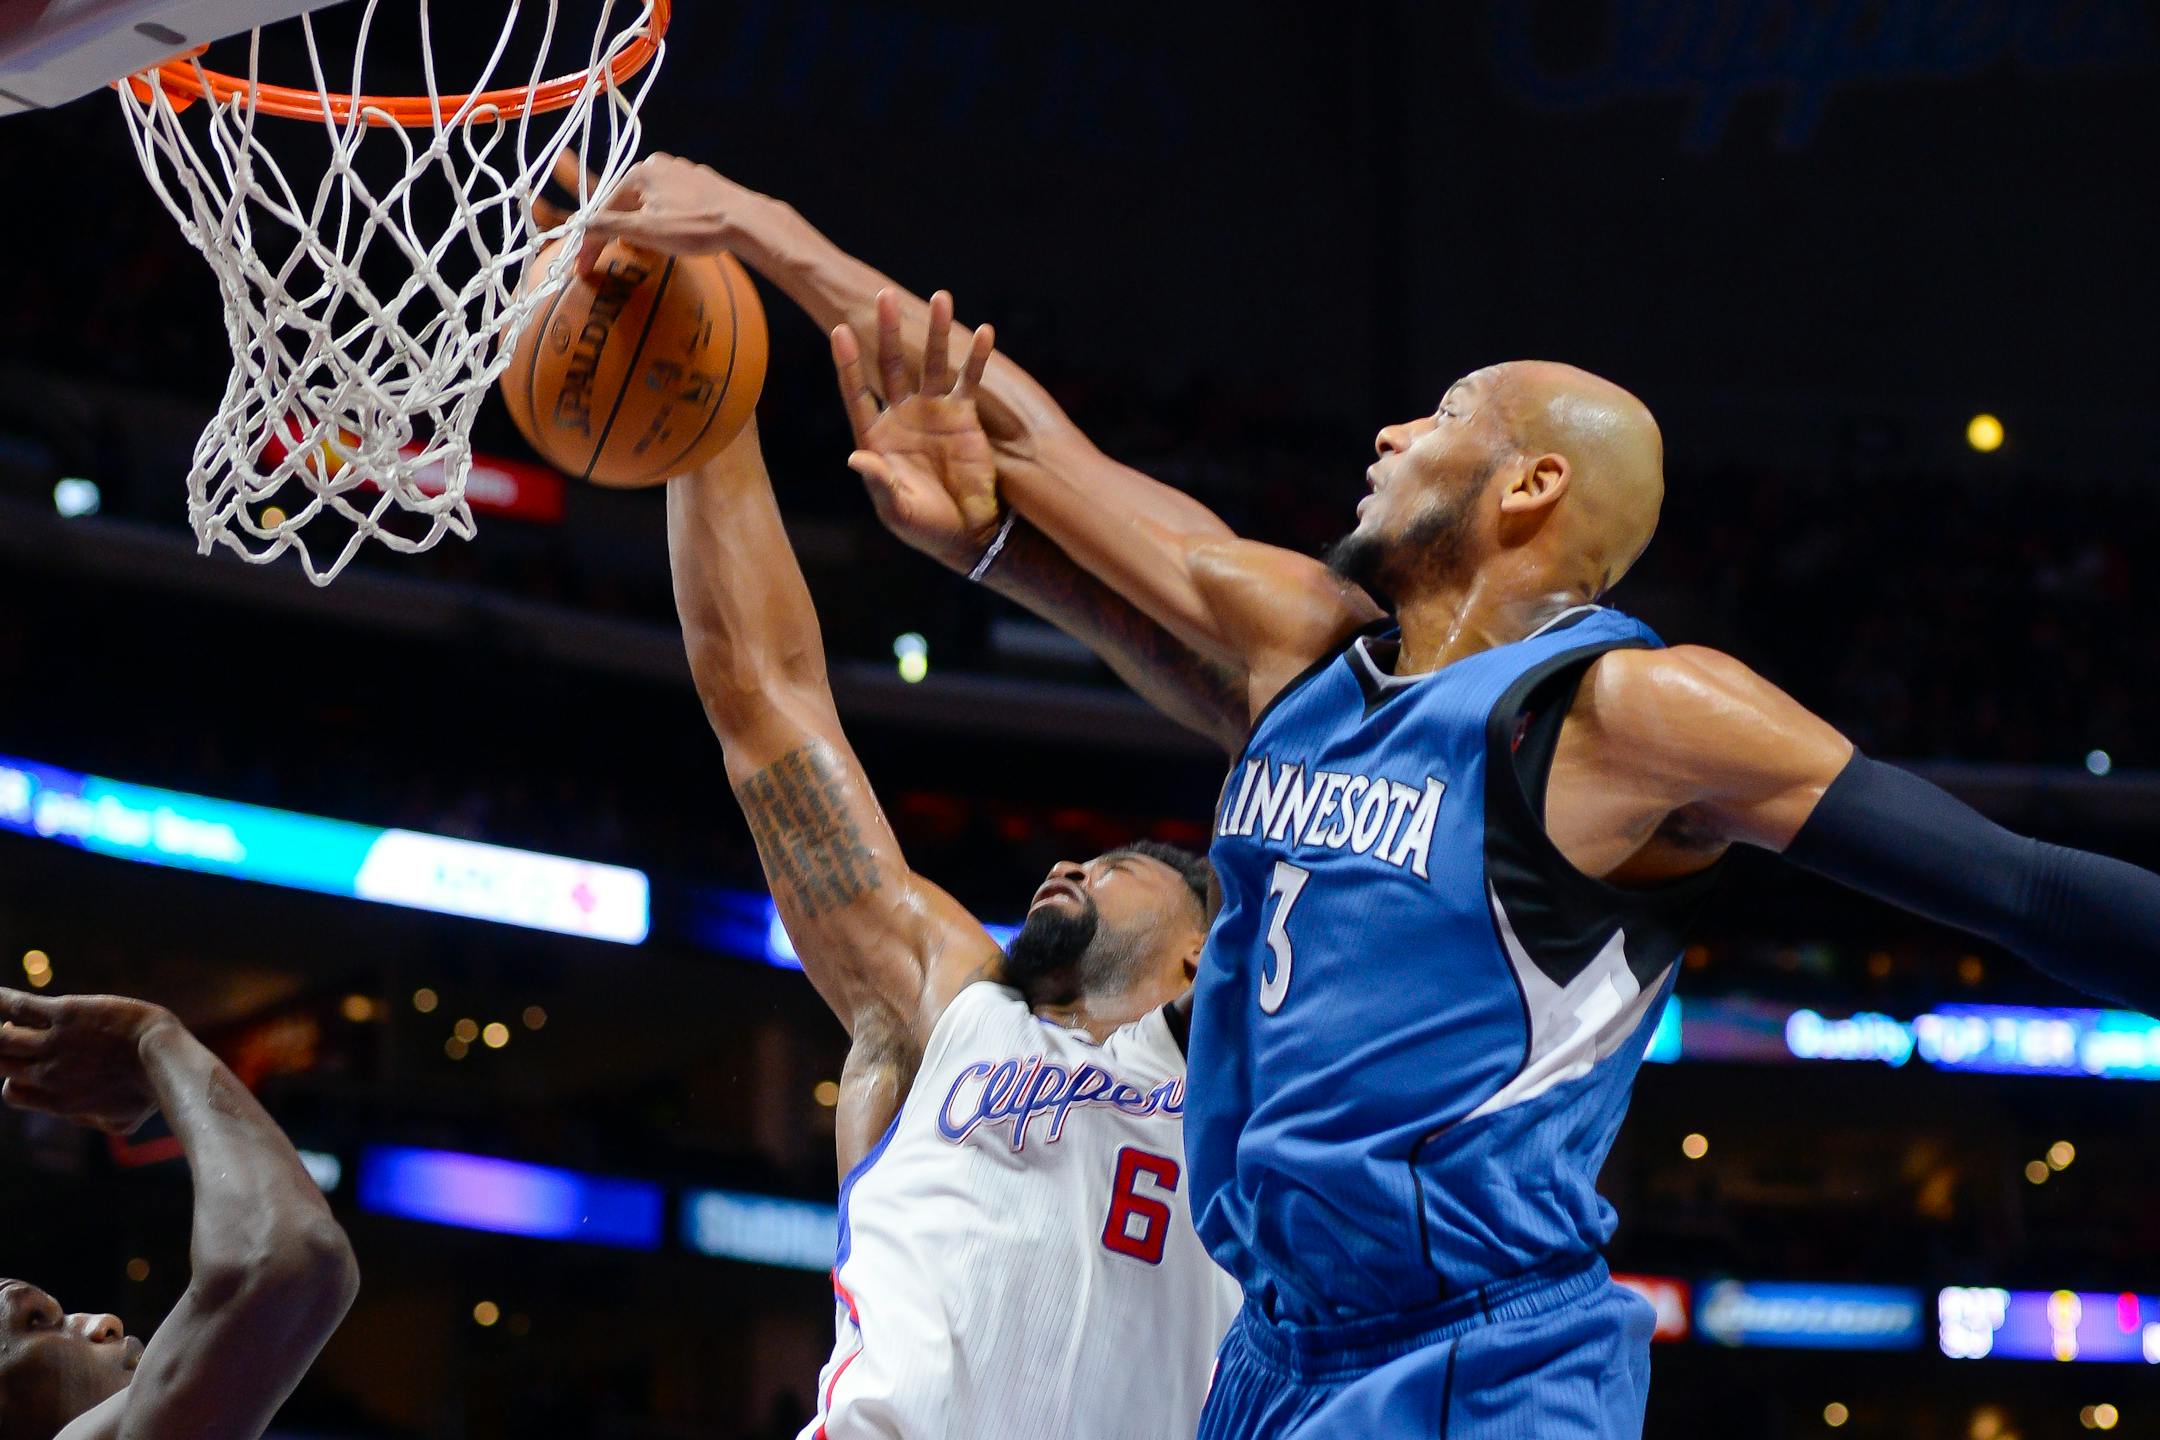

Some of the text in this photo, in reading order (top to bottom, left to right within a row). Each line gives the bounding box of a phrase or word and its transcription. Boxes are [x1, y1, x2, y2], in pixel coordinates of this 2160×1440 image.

[1218, 753, 1446, 881] INNESOTA
[1259, 860, 1310, 1015] 3
[936, 1054, 1184, 1153] Clipper
[1101, 1146, 1181, 1266] 6
